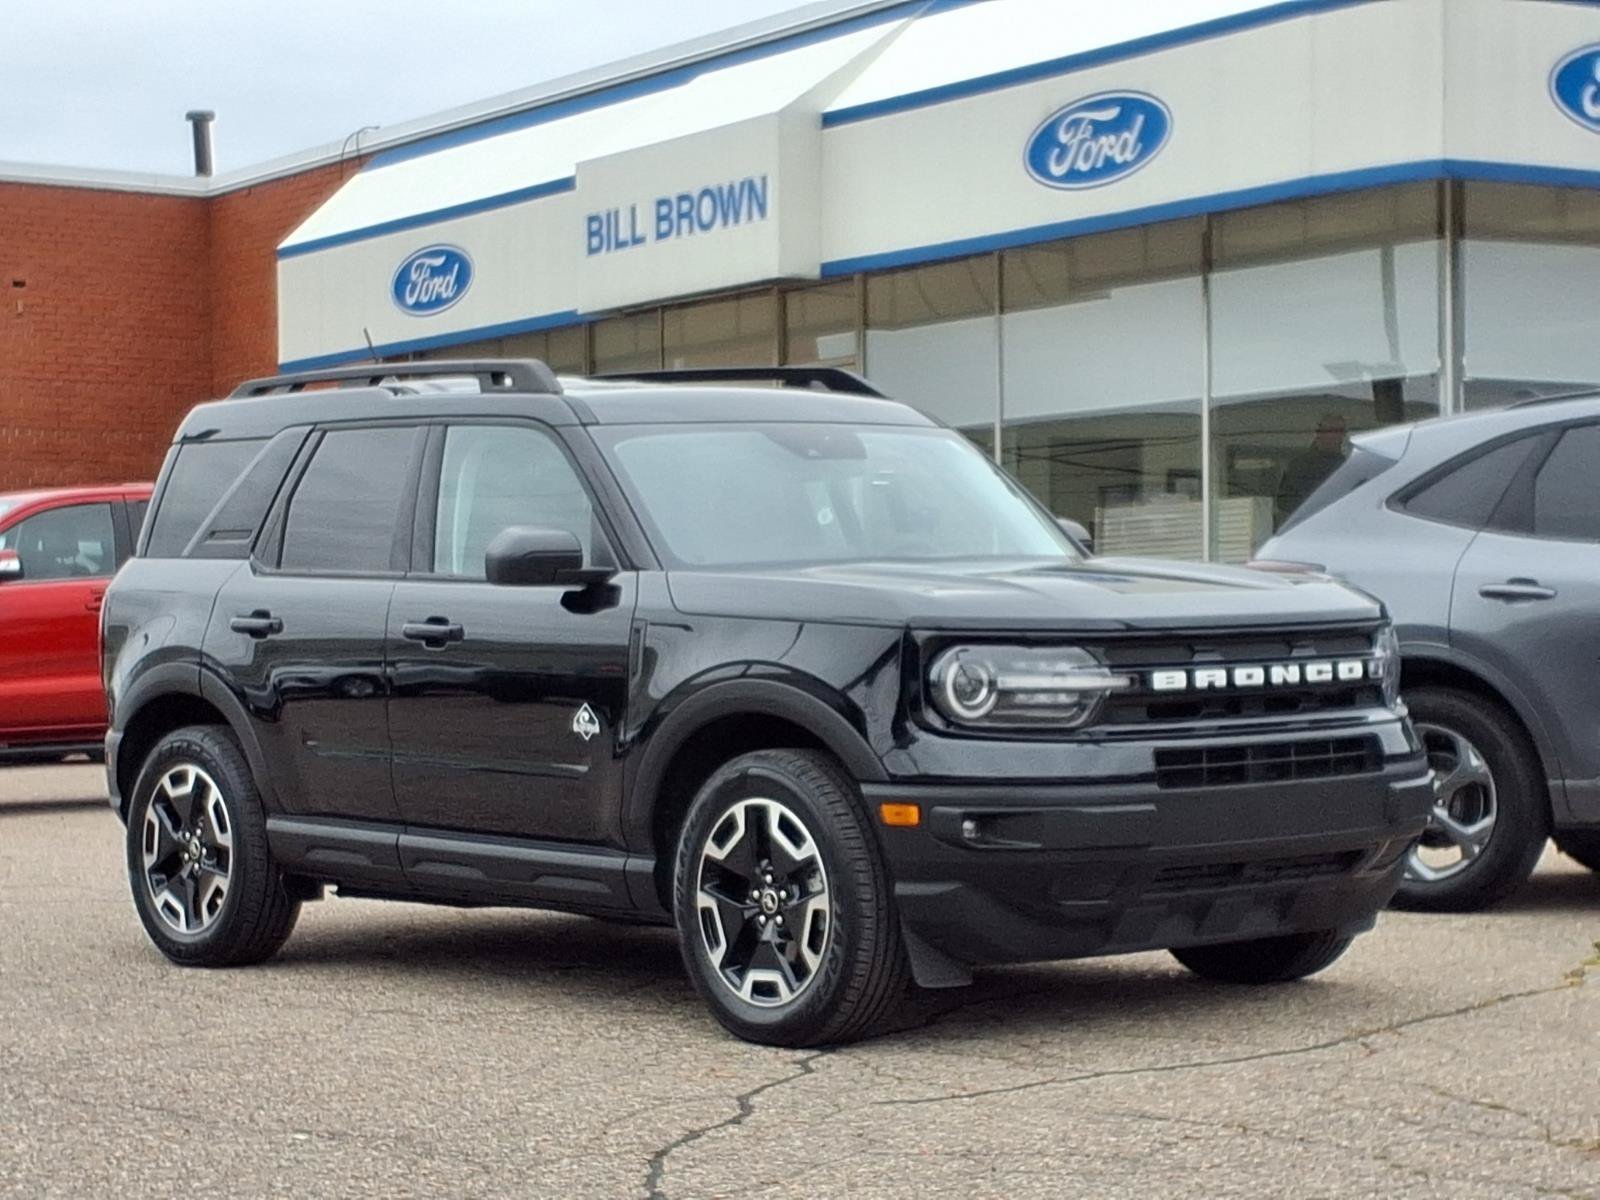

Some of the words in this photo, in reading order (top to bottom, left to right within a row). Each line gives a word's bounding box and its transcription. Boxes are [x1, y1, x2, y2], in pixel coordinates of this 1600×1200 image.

[1049, 106, 1144, 177] Ford
[587, 205, 646, 256] BILL
[656, 176, 767, 241] BROWN
[405, 255, 459, 306] Ford
[1152, 660, 1363, 691] BRONCO
